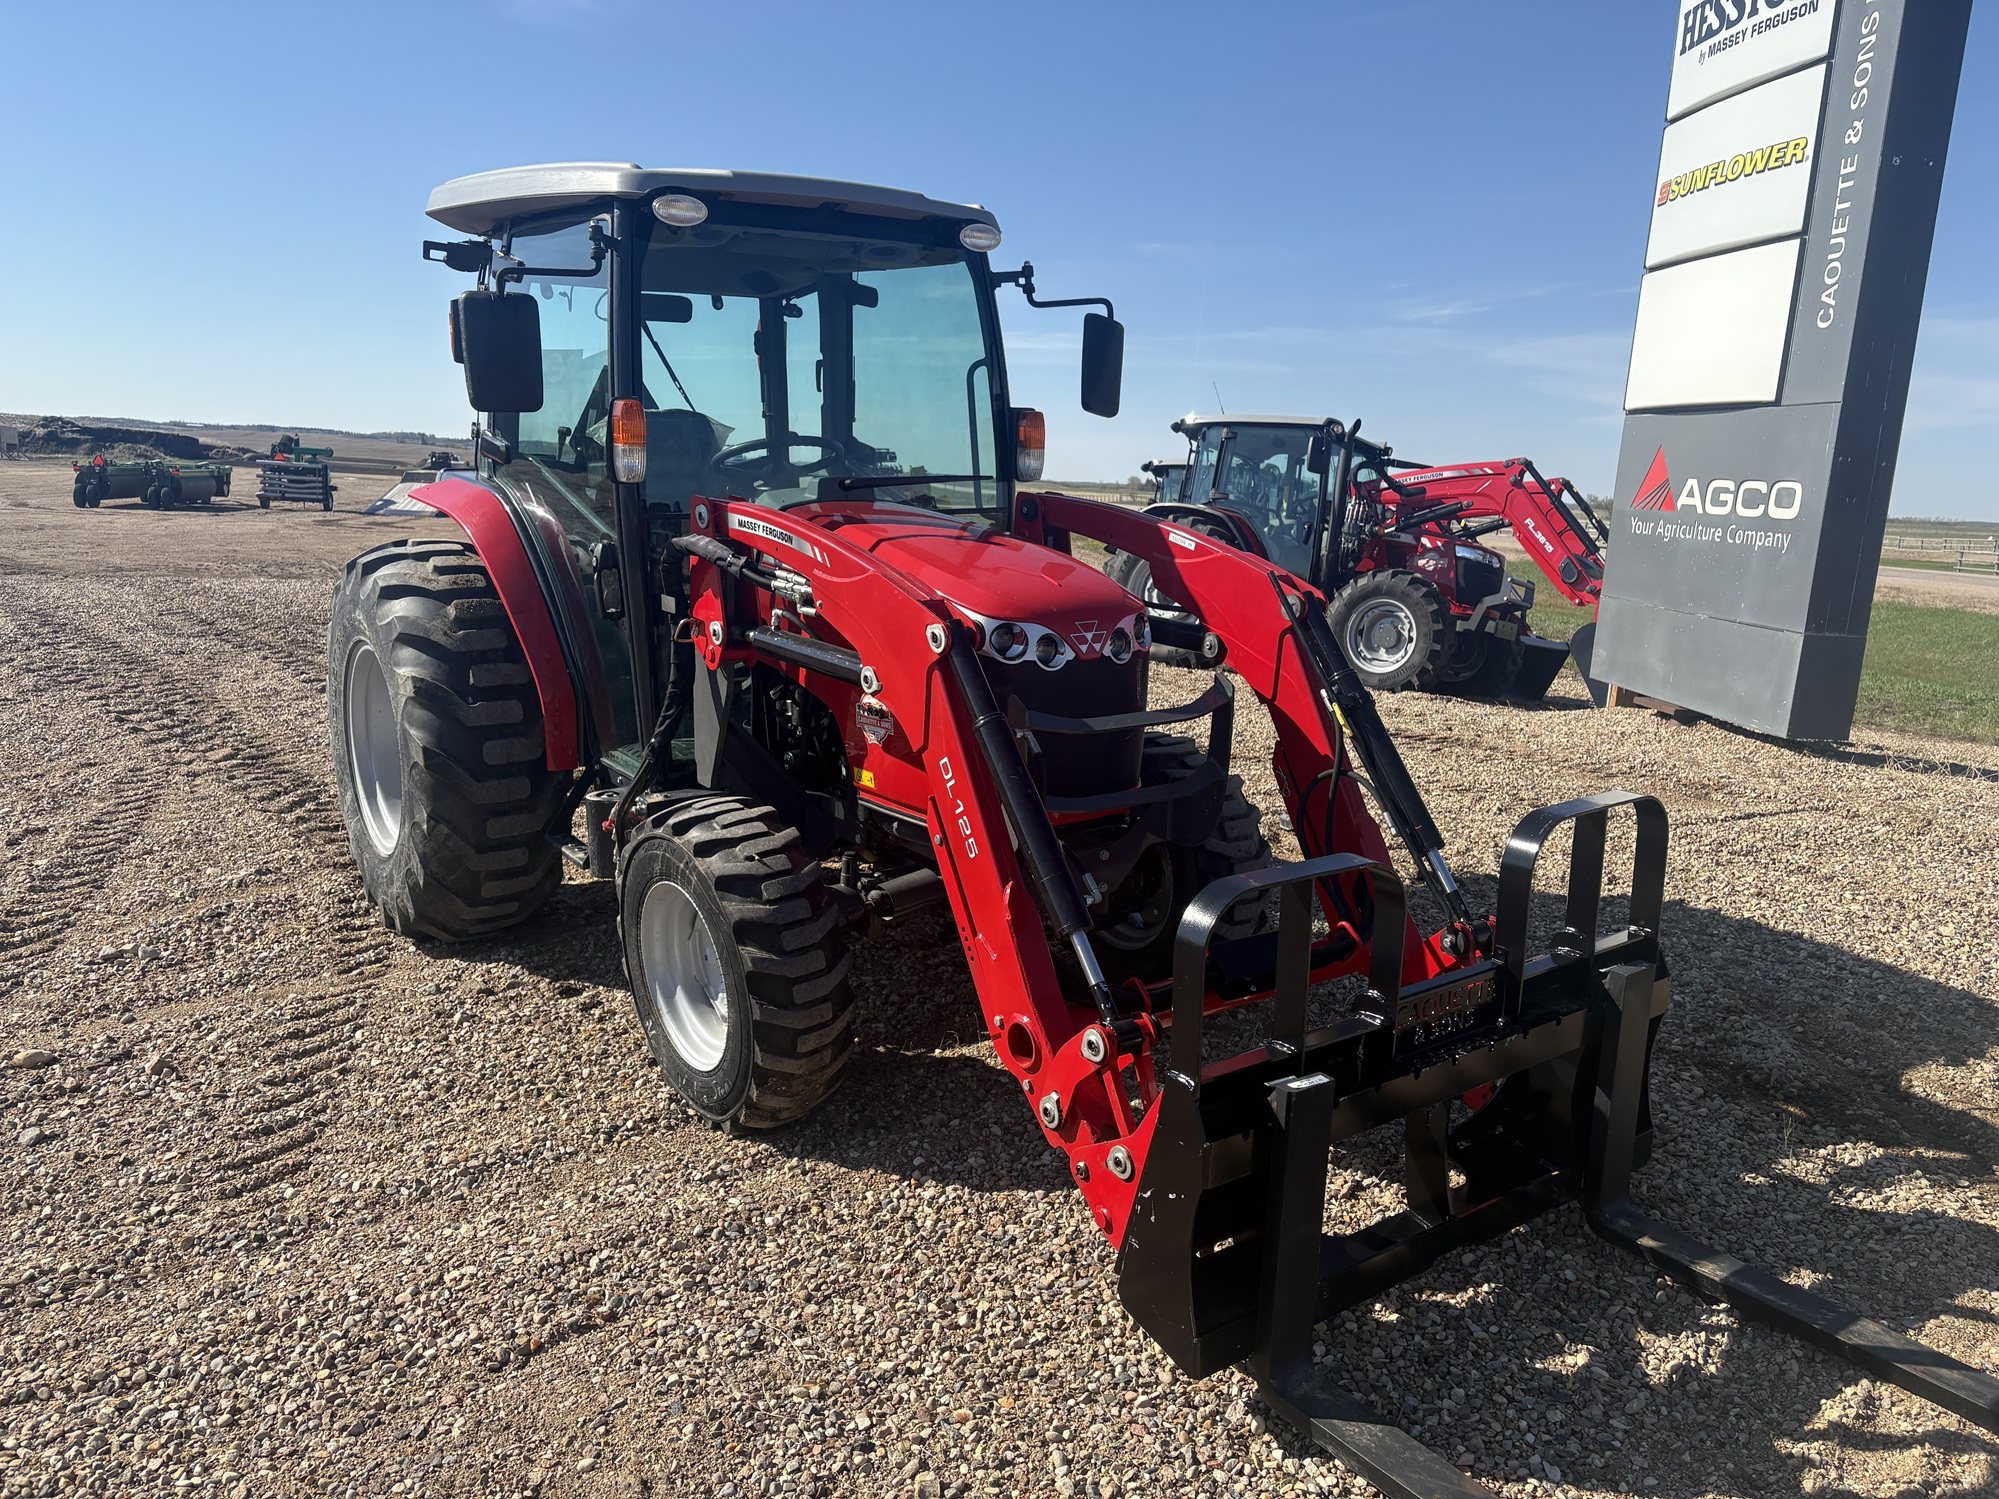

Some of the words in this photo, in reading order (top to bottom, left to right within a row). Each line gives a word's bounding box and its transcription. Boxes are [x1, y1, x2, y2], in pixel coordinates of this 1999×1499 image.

[1680, 0, 1813, 56] HESS
[1698, 50, 1707, 66] by
[1708, 27, 1748, 59] MASSEY
[1750, 0, 1819, 38] FERGUSON
[1850, 10, 1880, 109] SONS
[1845, 117, 1864, 144] &
[1668, 137, 1808, 202] SUNFLOWER
[1816, 153, 1858, 329] CAOUETTE
[1413, 472, 1444, 481] FERGUSON
[1676, 478, 1803, 520] AGCO
[737, 518, 761, 532] MASSEY
[762, 524, 794, 546] FERGUSON
[1630, 516, 1655, 536] Your
[1655, 518, 1723, 542] Agriculture
[1726, 524, 1792, 554] Company
